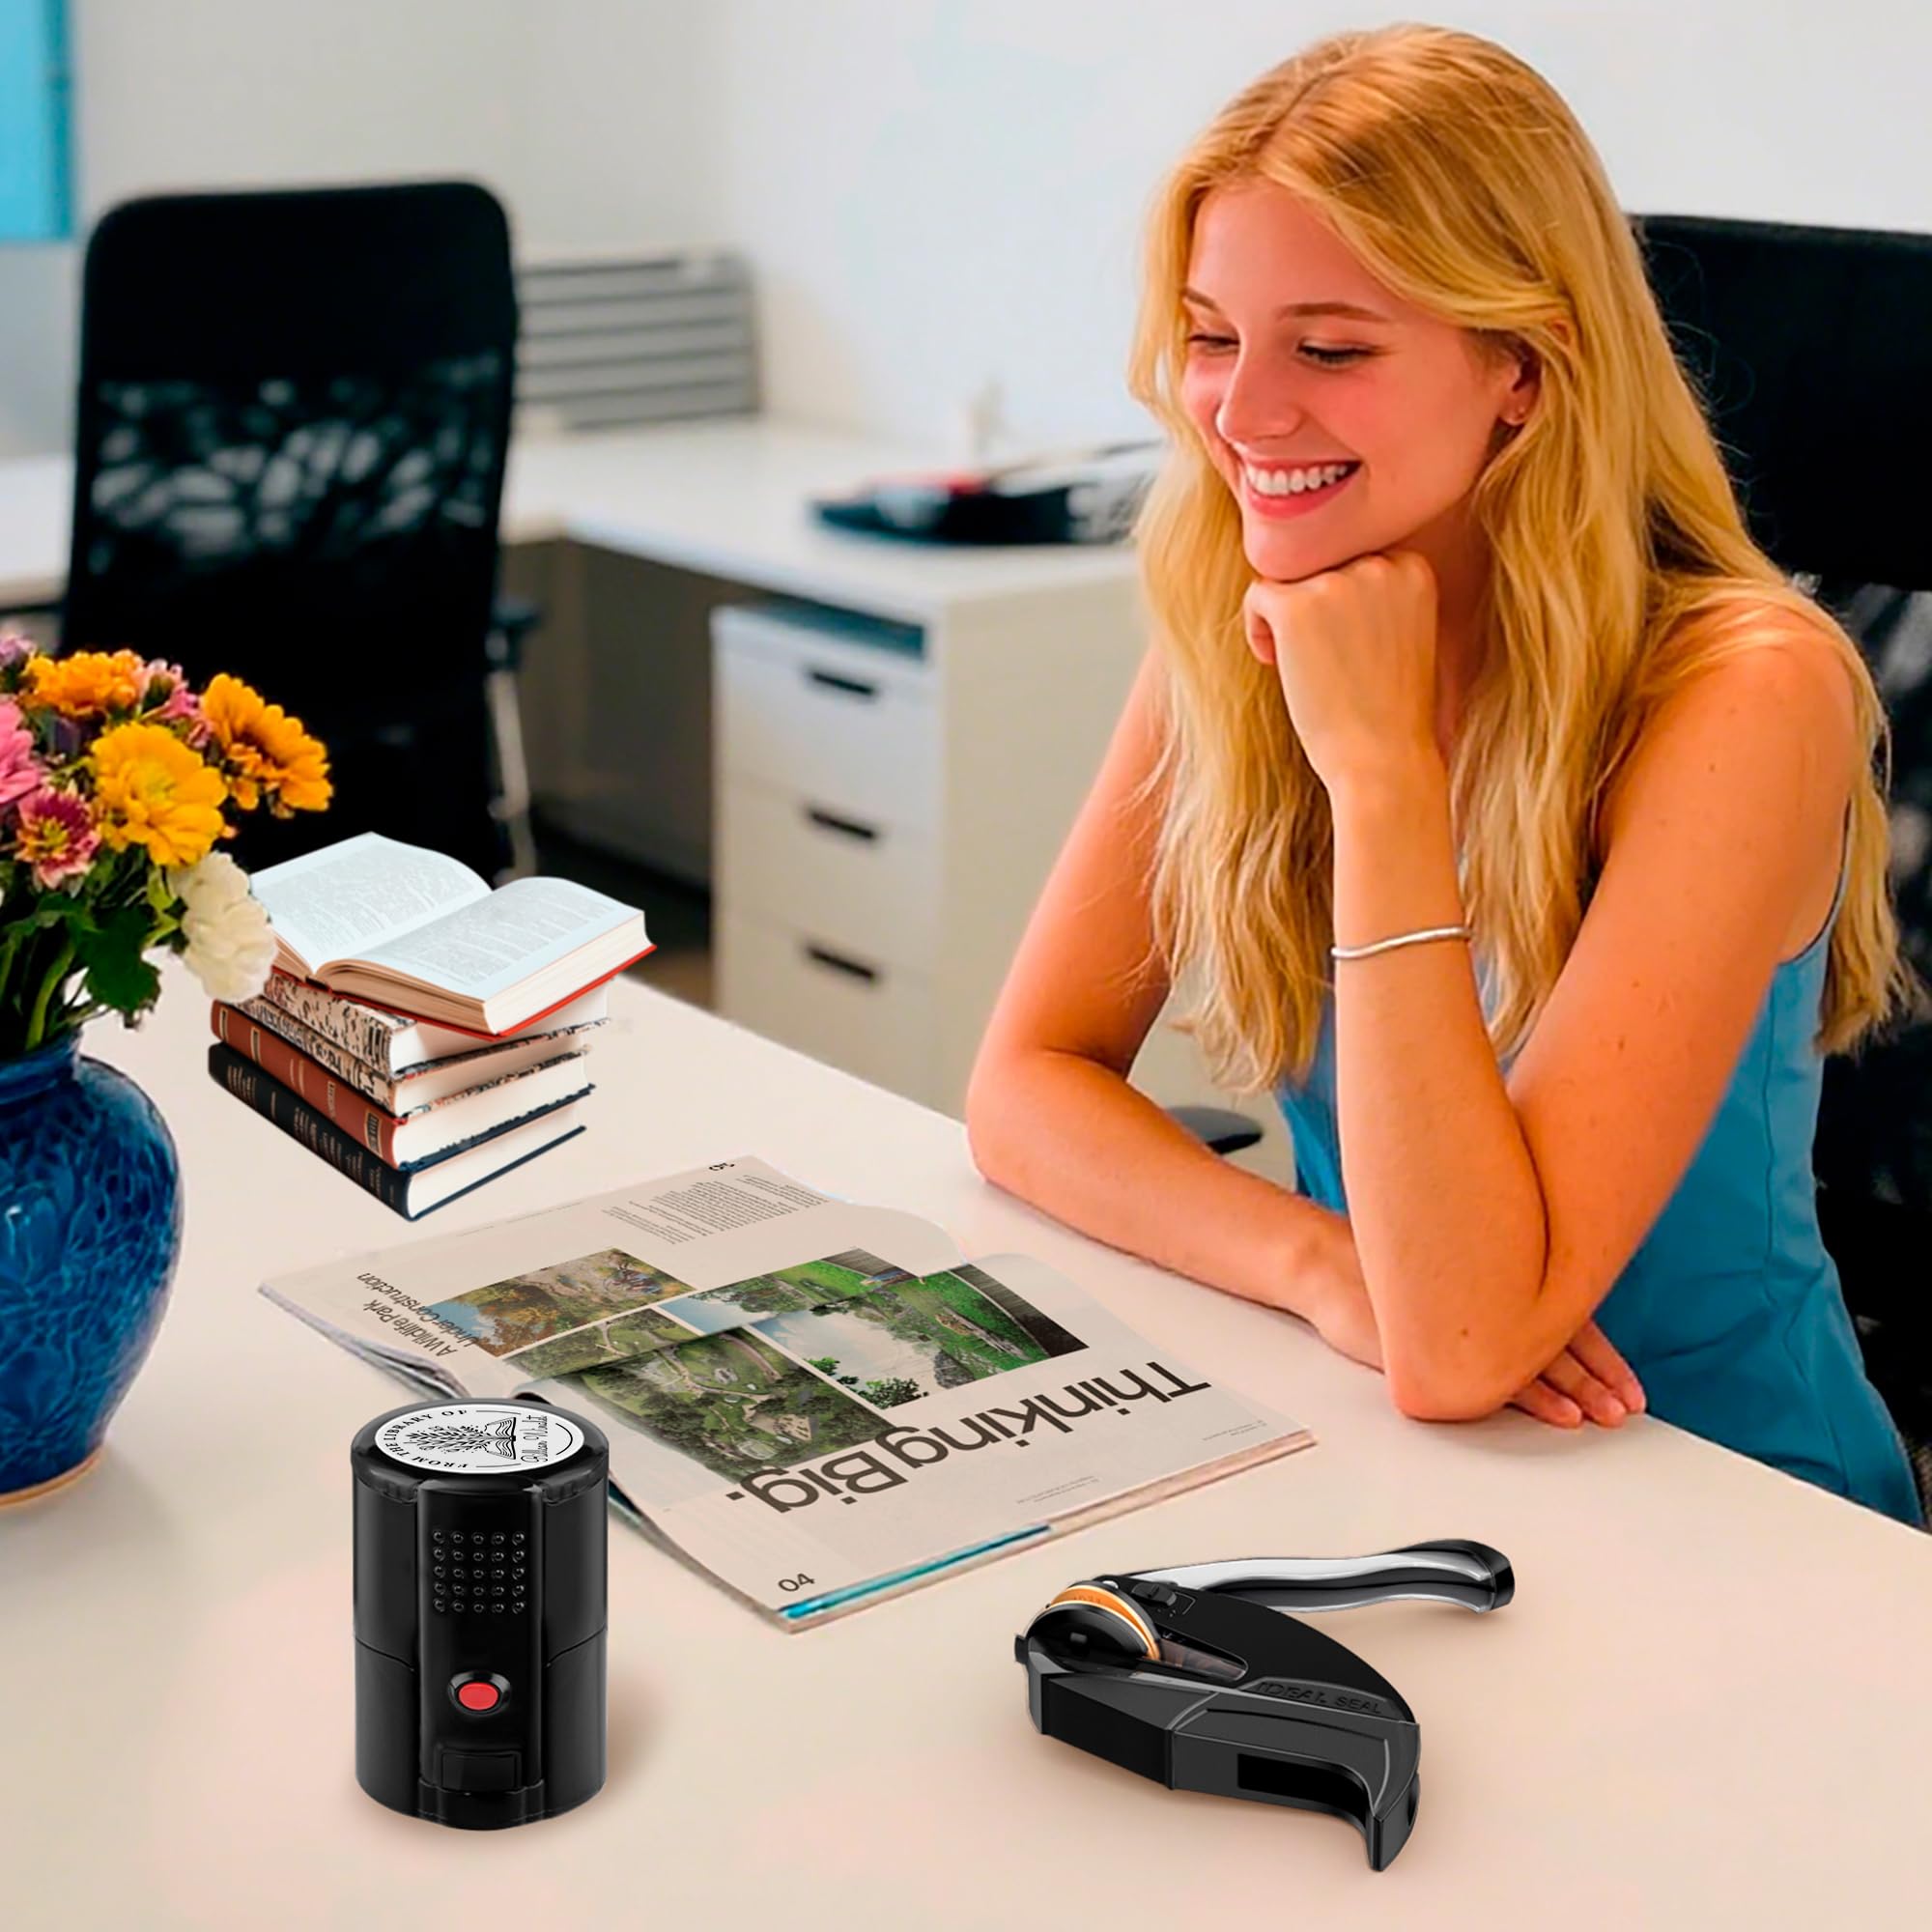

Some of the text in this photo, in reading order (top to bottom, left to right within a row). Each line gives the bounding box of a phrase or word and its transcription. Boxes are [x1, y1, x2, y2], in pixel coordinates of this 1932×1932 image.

[356, 1272, 480, 1348] Under Construction
[363, 1299, 459, 1357] A Wildlife Park
[383, 1413, 434, 1441] LIBRARY
[725, 1360, 1212, 1514] Thinking Big.
[385, 1442, 411, 1457] THE
[412, 1456, 469, 1468] FROM
[778, 1573, 816, 1592] 04
[1258, 1681, 1382, 1715] IDEAL SEAL
